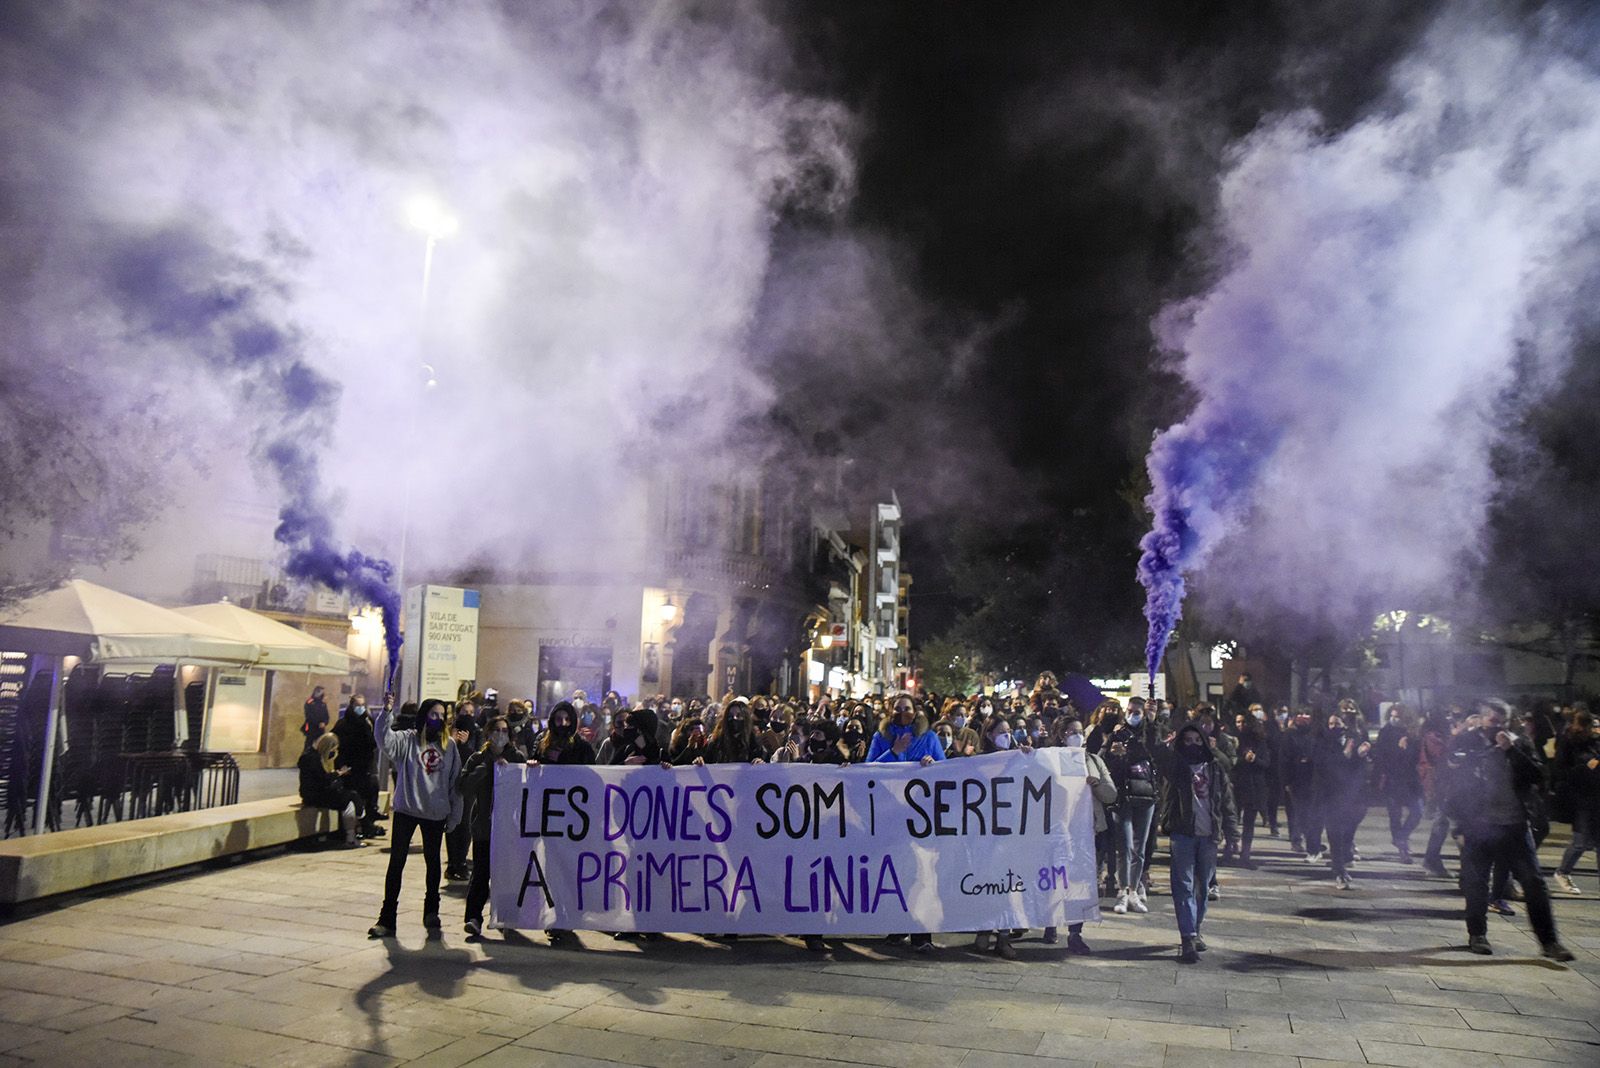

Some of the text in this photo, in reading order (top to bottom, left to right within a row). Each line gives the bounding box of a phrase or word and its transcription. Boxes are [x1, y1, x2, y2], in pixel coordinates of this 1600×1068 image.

[429, 612, 457, 622] VILA DE
[429, 622, 448, 631] SANT
[441, 632, 462, 642] ANYS
[520, 785, 590, 841] LES
[604, 783, 735, 843] DONES
[755, 781, 846, 840] SOM
[904, 775, 1052, 839] SEREM
[517, 850, 555, 908] A
[960, 865, 1069, 896] Comitè 8M
